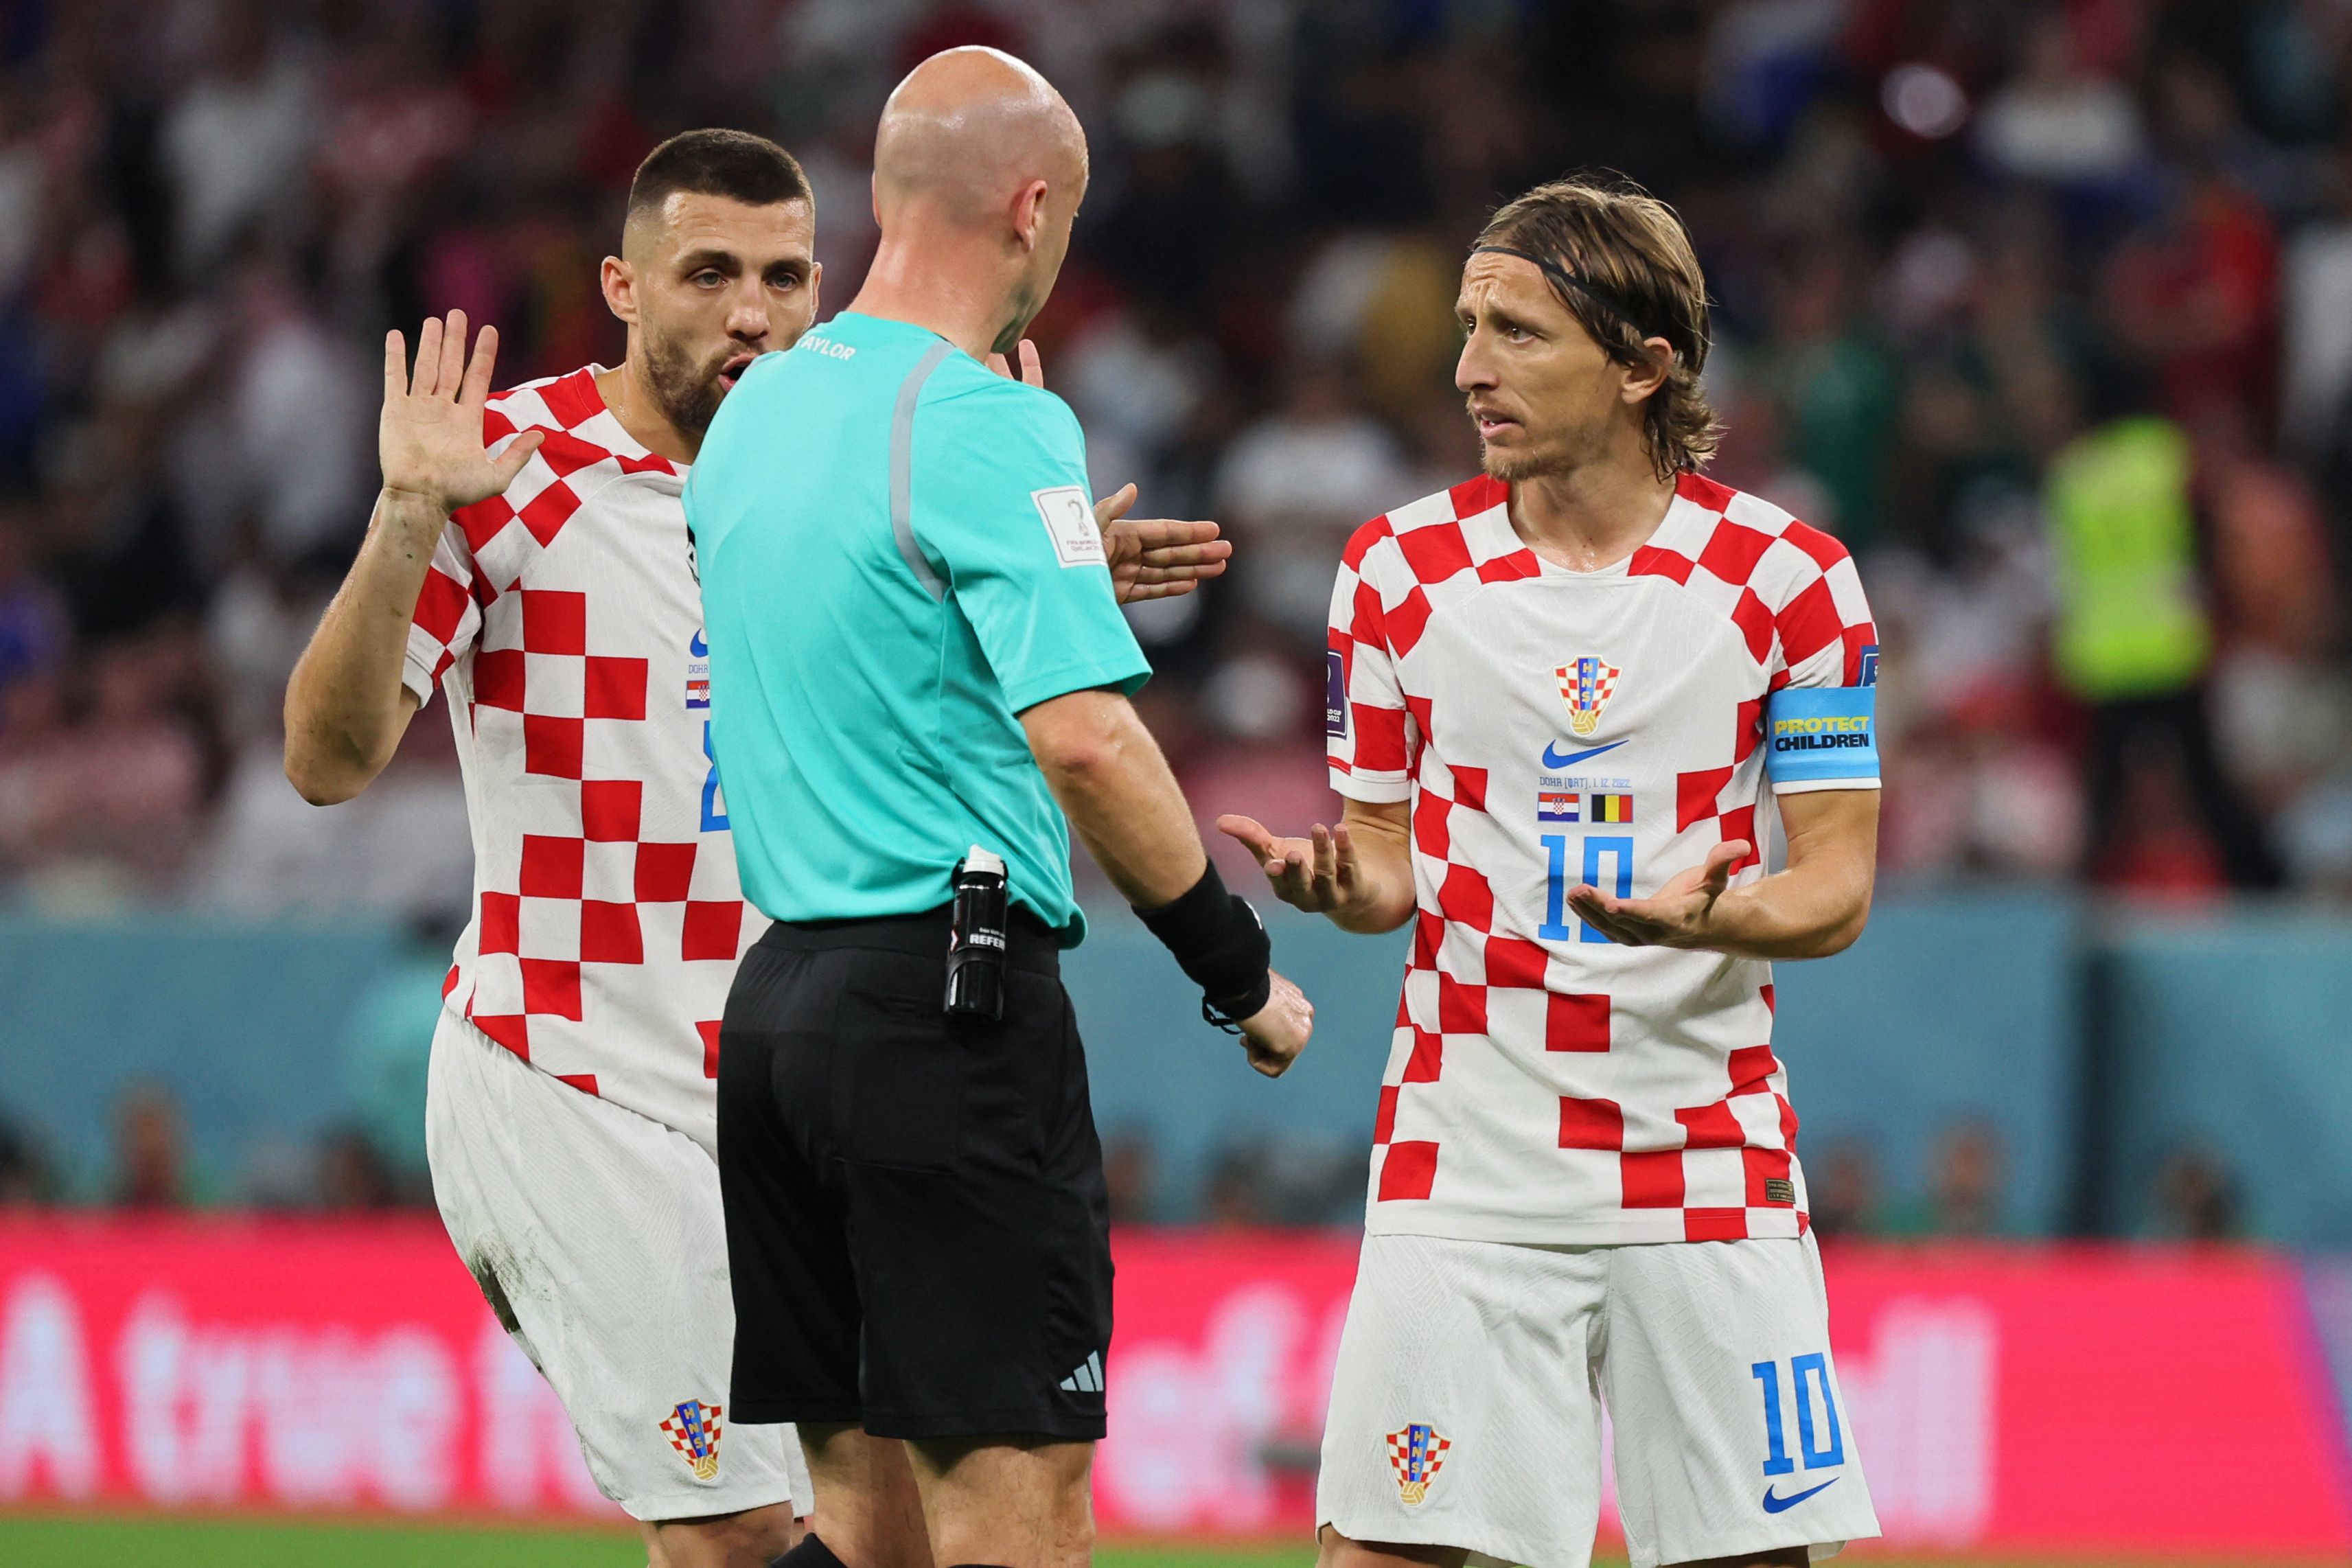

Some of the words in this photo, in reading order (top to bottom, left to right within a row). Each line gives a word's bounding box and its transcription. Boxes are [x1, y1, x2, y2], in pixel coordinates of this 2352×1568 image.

[1582, 662, 1593, 702] HNS
[1774, 716, 1869, 735] PROTECT
[1775, 734, 1869, 752] CHILDREN
[1540, 776, 1562, 787] DOHA
[1538, 835, 1633, 943] 10
[683, 1407, 703, 1449] HNS
[1751, 1352, 1844, 1476] 10
[1411, 1431, 1425, 1473] HNS
